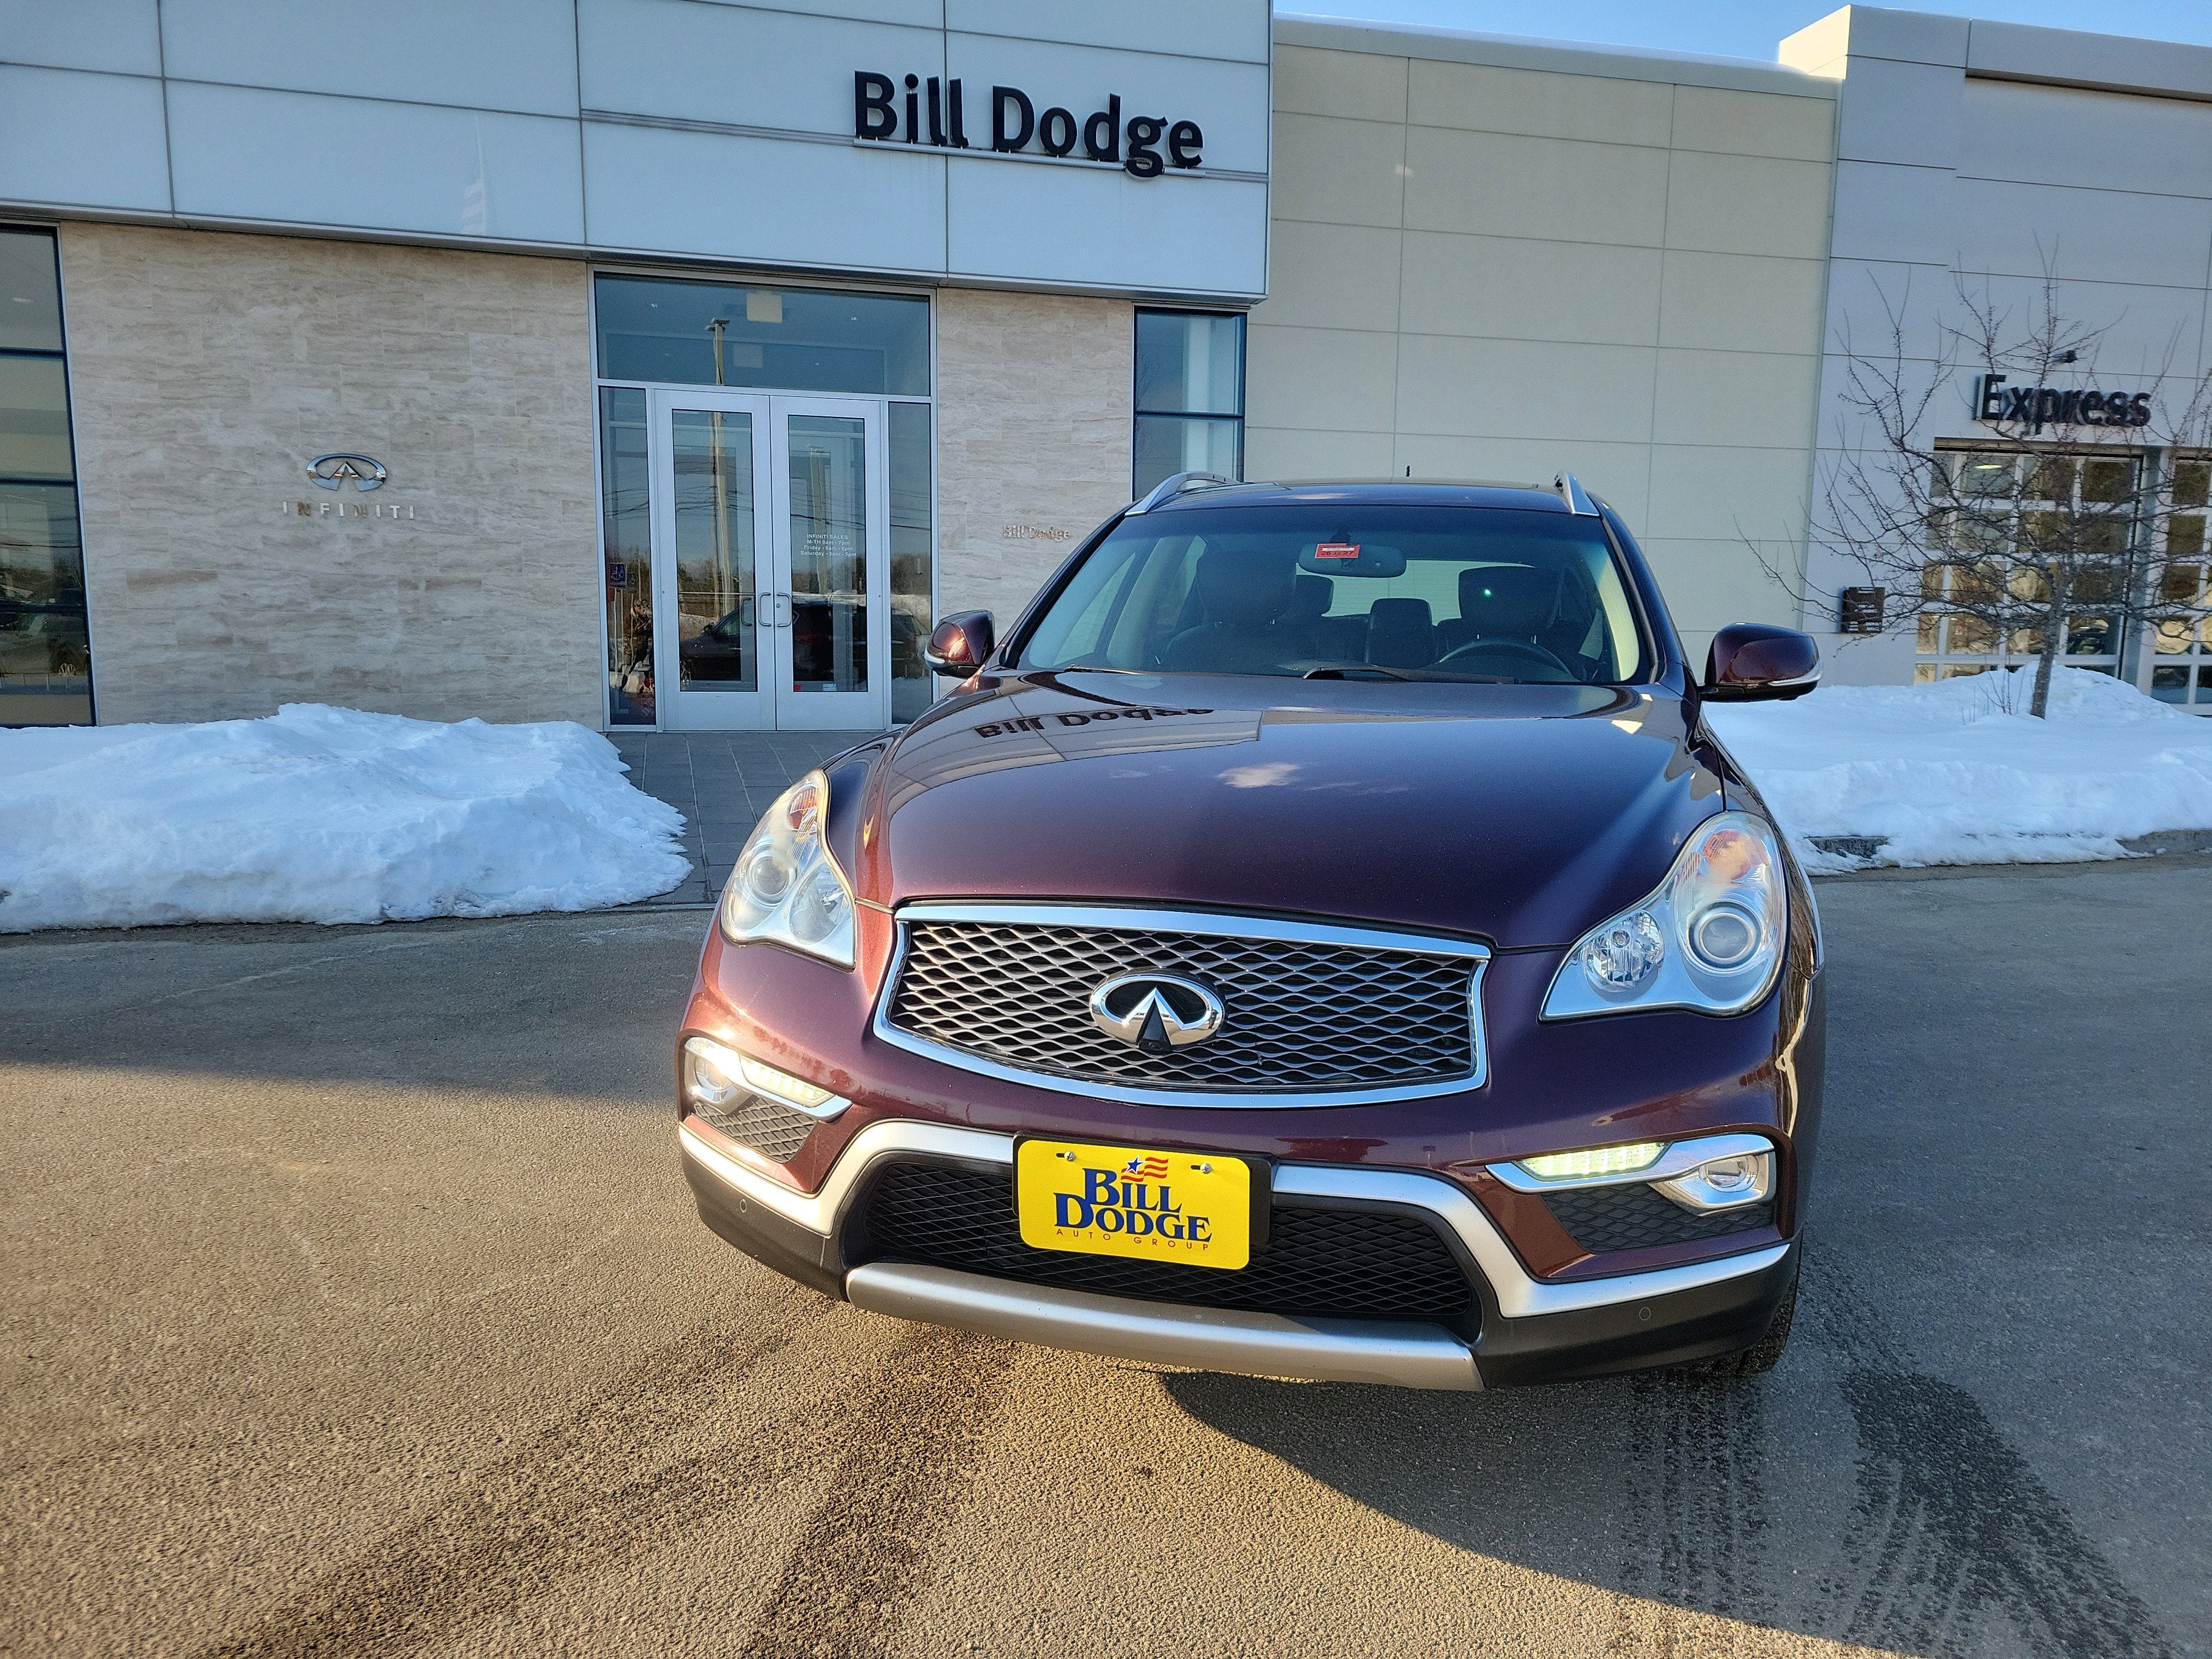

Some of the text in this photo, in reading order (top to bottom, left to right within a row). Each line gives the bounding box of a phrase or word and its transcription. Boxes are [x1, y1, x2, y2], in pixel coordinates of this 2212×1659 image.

[854, 70, 1204, 178] Bill Dodge
[1975, 374, 2152, 435] Express
[282, 500, 414, 520] INFINITI
[1003, 524, 1071, 542] Bill Dodge
[1082, 1167, 1182, 1213] BILL
[1053, 1192, 1212, 1242] DODGE
[1057, 1228, 1209, 1251] AUTO GROUP
